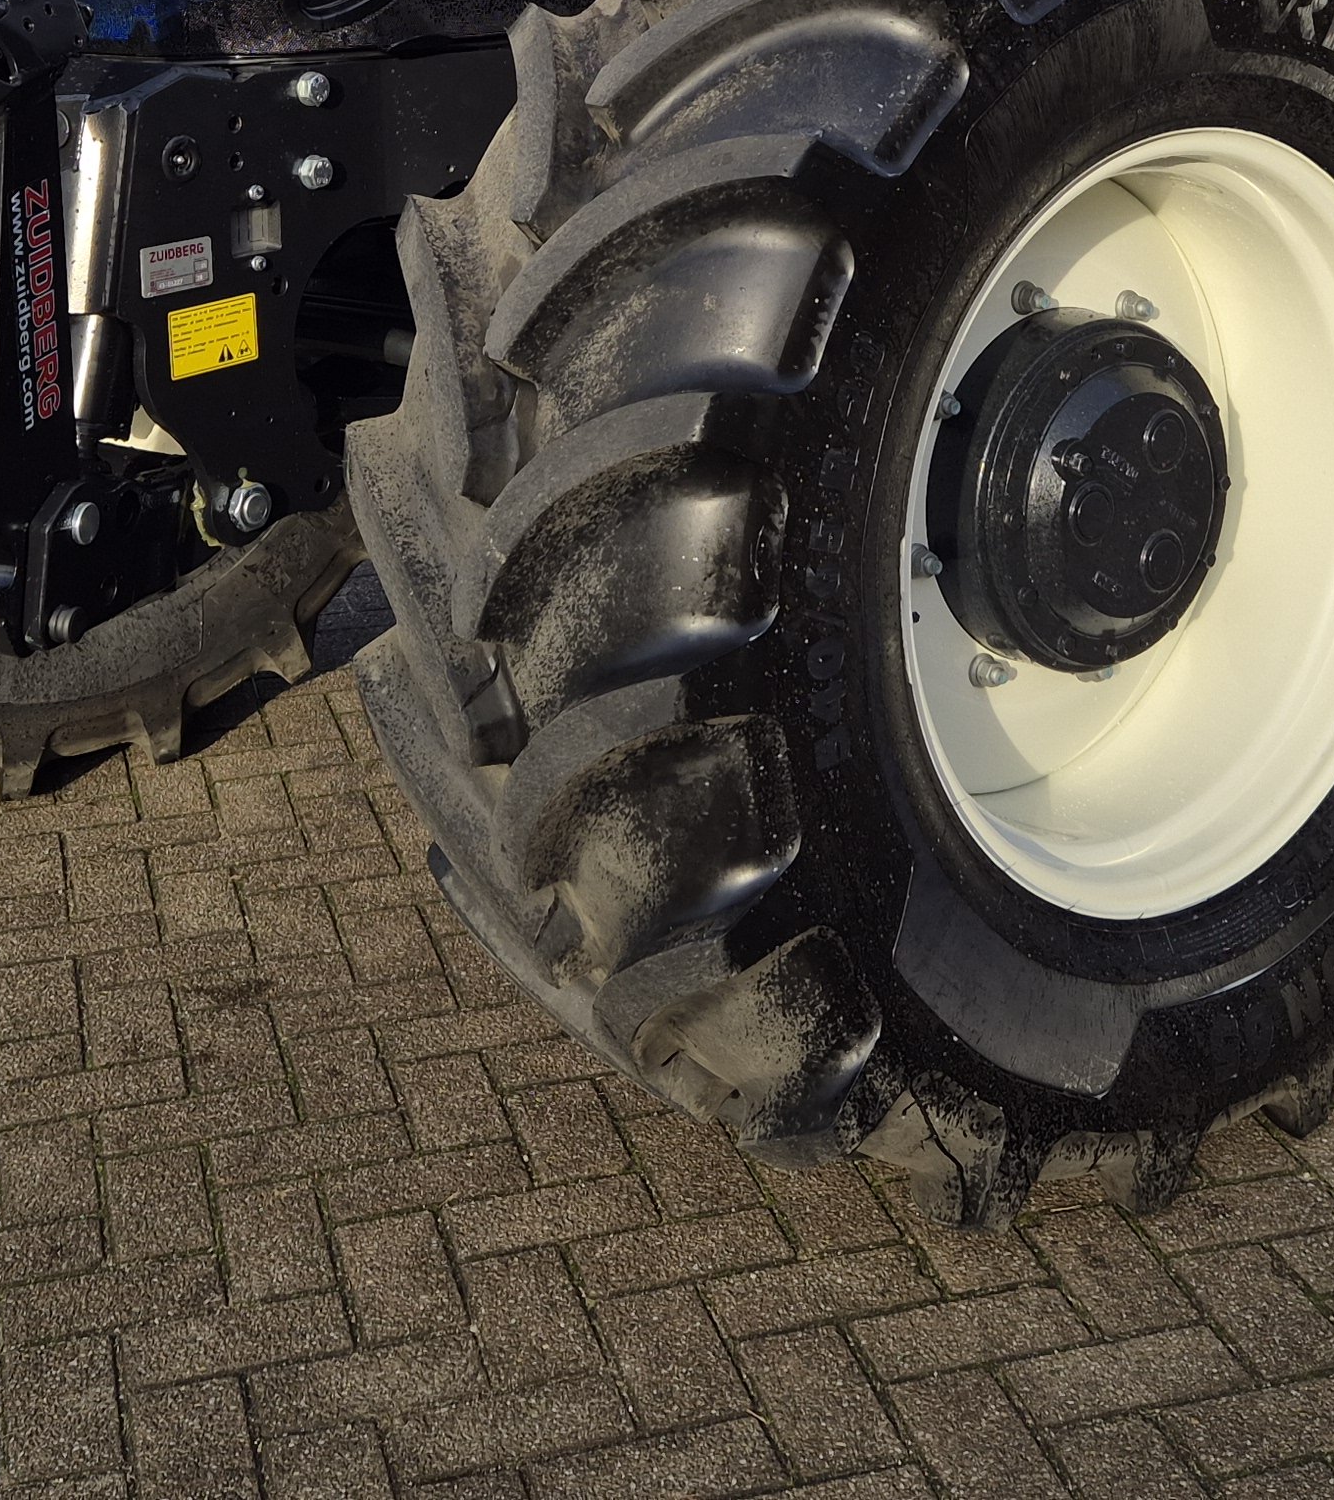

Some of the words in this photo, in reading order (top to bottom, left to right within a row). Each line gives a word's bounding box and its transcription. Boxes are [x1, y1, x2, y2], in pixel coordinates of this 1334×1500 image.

[10, 191, 35, 431] www.zuidberg.com
[25, 178, 61, 419] ZUIDBERG
[149, 243, 204, 263] ZUIDBERG
